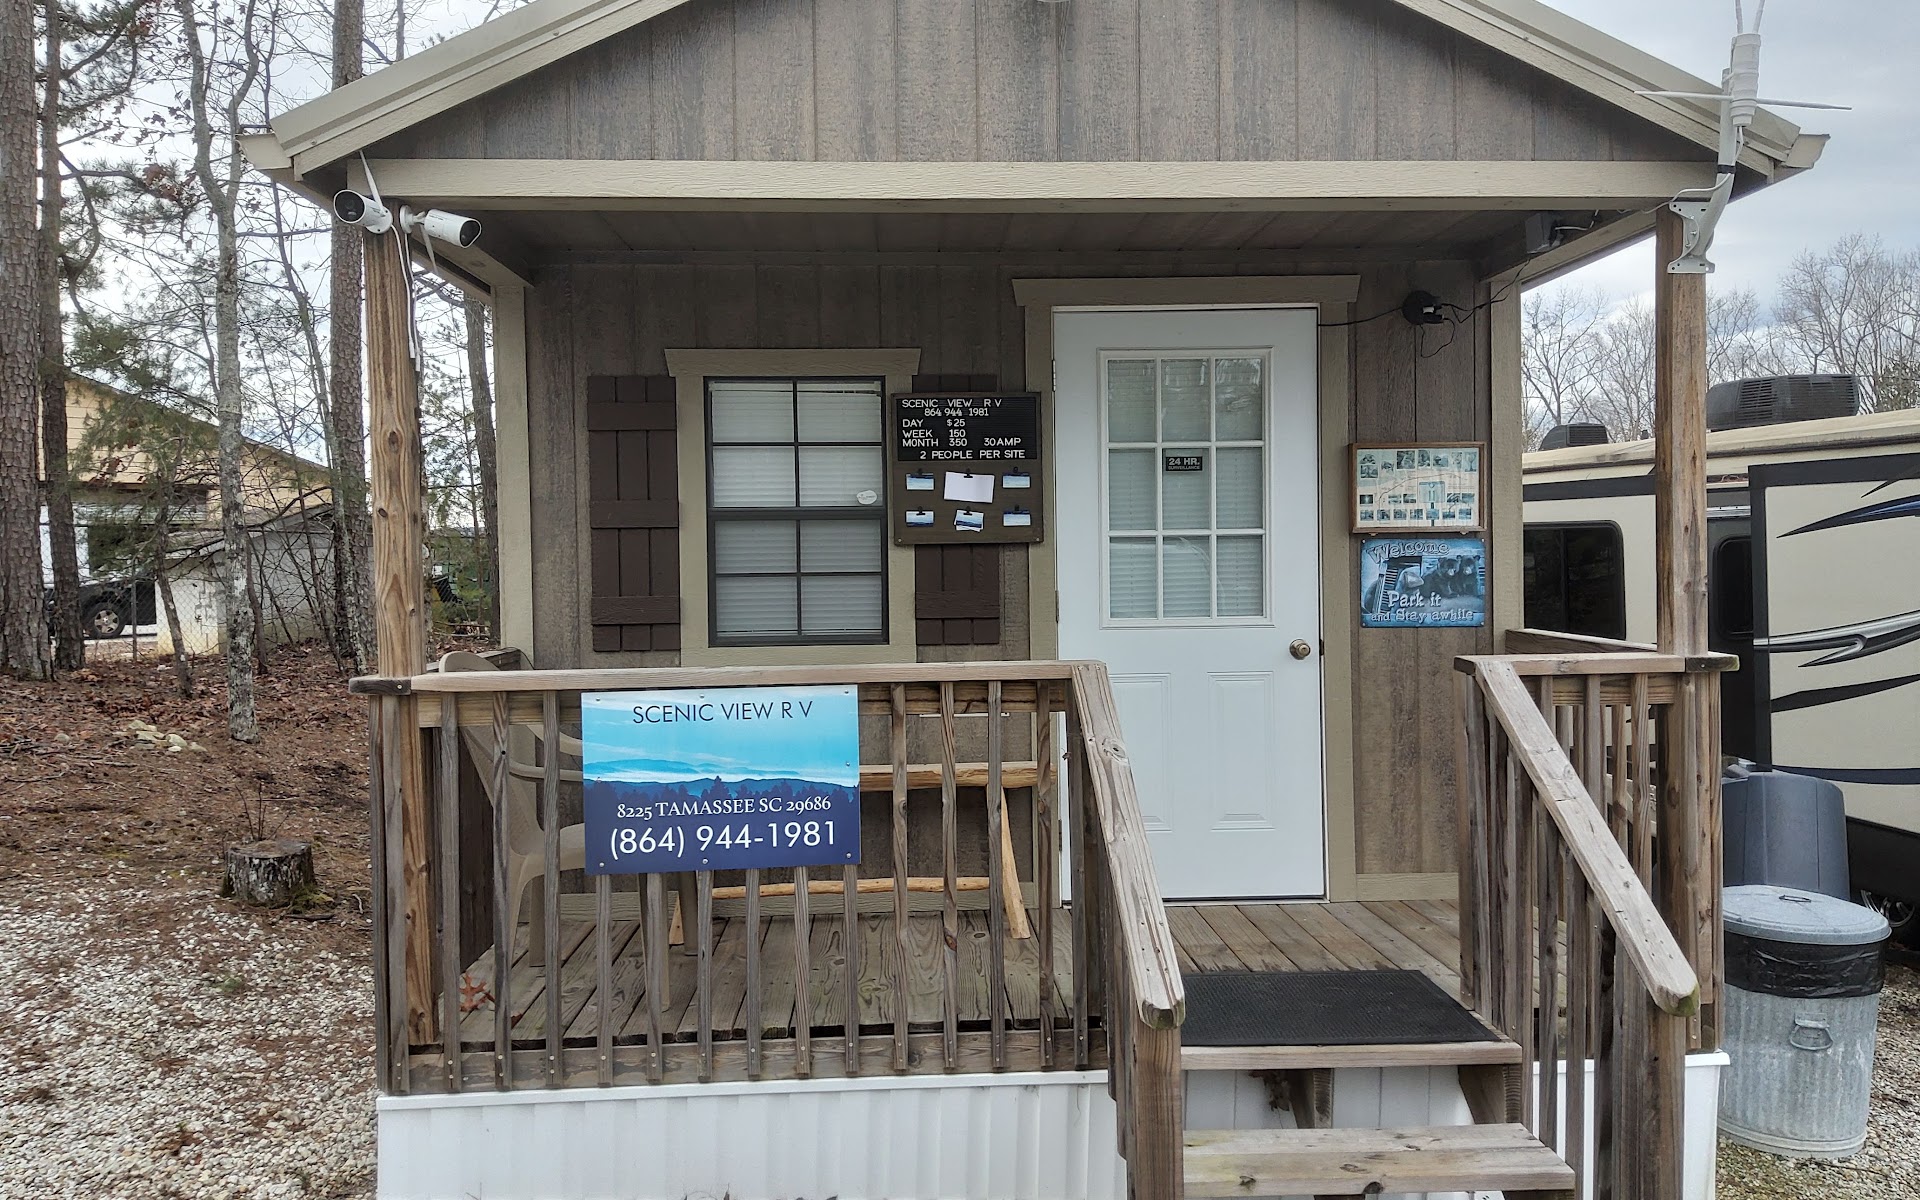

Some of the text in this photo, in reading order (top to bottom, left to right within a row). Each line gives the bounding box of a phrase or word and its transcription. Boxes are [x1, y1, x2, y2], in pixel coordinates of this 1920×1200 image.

[902, 399, 1001, 408] SCENIC VIEW R V
[924, 408, 988, 416] 864 944 1981
[902, 419, 923, 427] DAY
[902, 430, 932, 438] WEEK
[902, 439, 938, 447] MONTH
[949, 439, 967, 447] 350
[920, 450, 1025, 459] 2 PEOPLE PER SITE
[1366, 542, 1450, 564] Welcome
[1387, 591, 1441, 608] Park it
[1371, 609, 1473, 623] and Stay awhile
[633, 701, 813, 724] SCENIC VIEW R V
[617, 796, 831, 820] 8225 TAMASSEE SC 29686
[610, 820, 835, 861] (864) 944-1981
